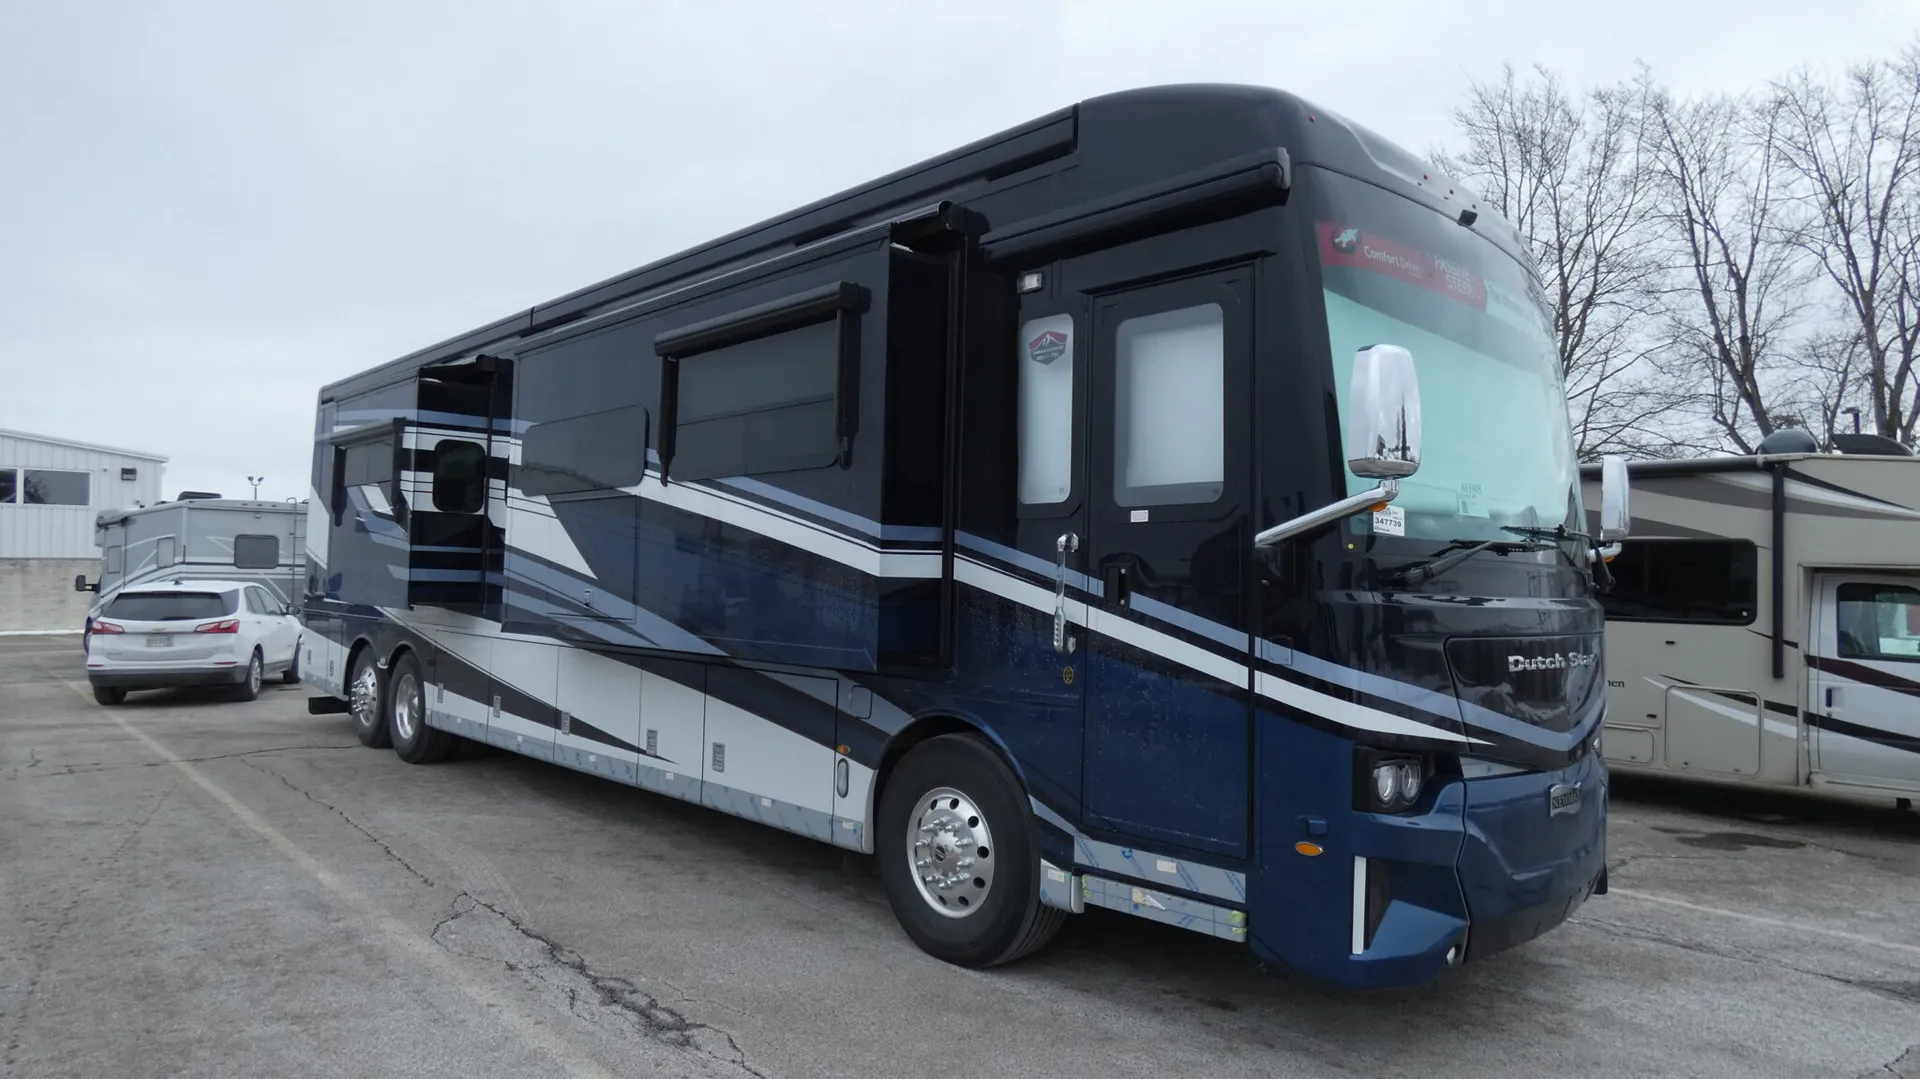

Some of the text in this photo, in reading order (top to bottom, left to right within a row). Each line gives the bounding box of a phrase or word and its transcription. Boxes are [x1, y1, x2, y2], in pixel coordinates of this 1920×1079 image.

[1374, 516, 1402, 528] 347739
[1507, 651, 1595, 673] Dutch Star
